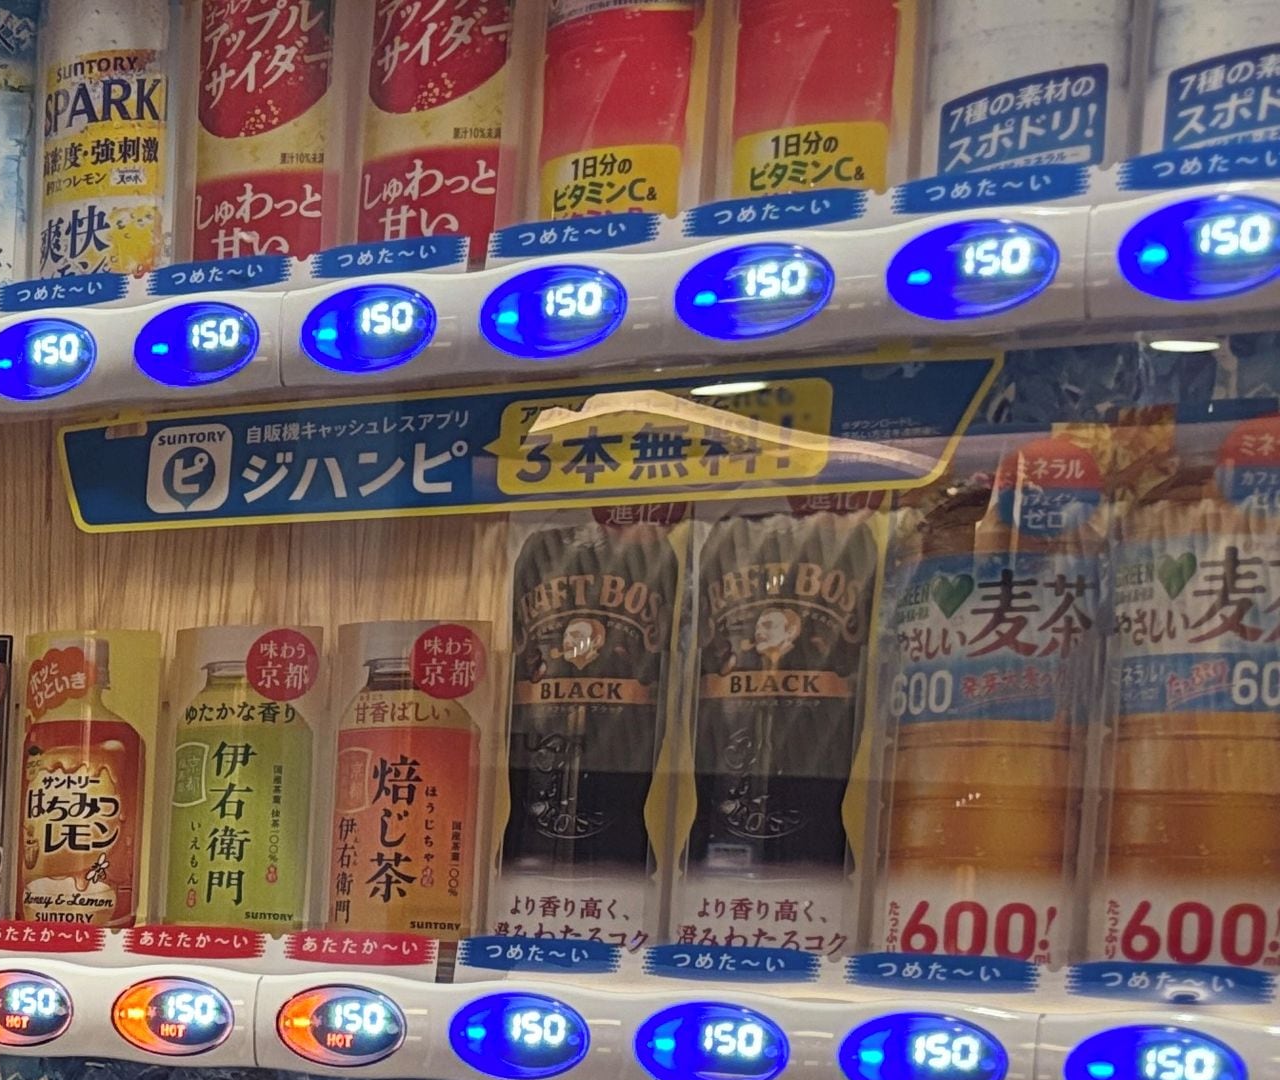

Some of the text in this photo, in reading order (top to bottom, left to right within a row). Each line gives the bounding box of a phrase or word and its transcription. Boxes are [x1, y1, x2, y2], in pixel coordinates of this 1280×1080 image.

[56, 54, 138, 83] SUNTORY
[44, 78, 160, 138] SPARK
[949, 73, 1096, 128] 7種の素材の
[770, 133, 839, 158] 1日分の
[570, 154, 633, 181] 1日分の
[362, 157, 497, 213] しゅわっと
[195, 182, 323, 228] しゅわっと
[1199, 218, 1271, 255] 150
[361, 302, 413, 334] 150
[157, 431, 226, 446] SUNTORY
[245, 410, 470, 445] 自販機キャッシュレスアプリ
[241, 440, 469, 505] ジハンピ
[967, 568, 1097, 660] 麦茶
[259, 641, 307, 661] 味わう
[423, 637, 473, 658] 味わう
[256, 661, 310, 690] 京都
[421, 656, 477, 687] 京都
[728, 672, 822, 697] BLACK
[540, 679, 623, 702] BLACK
[185, 702, 297, 725] ゆたかな香り
[26, 791, 120, 821] はちみつ
[44, 822, 120, 853] レモン
[206, 741, 257, 906] 伊右衛門
[365, 754, 423, 903] 焙じ茶
[423, 786, 438, 863] ほうじちゃ
[186, 821, 202, 885] いえもん
[508, 896, 632, 924] より香り高く、
[696, 896, 829, 924] より香り高く、
[6, 1015, 29, 1030] HOT
[511, 1013, 566, 1044] 150
